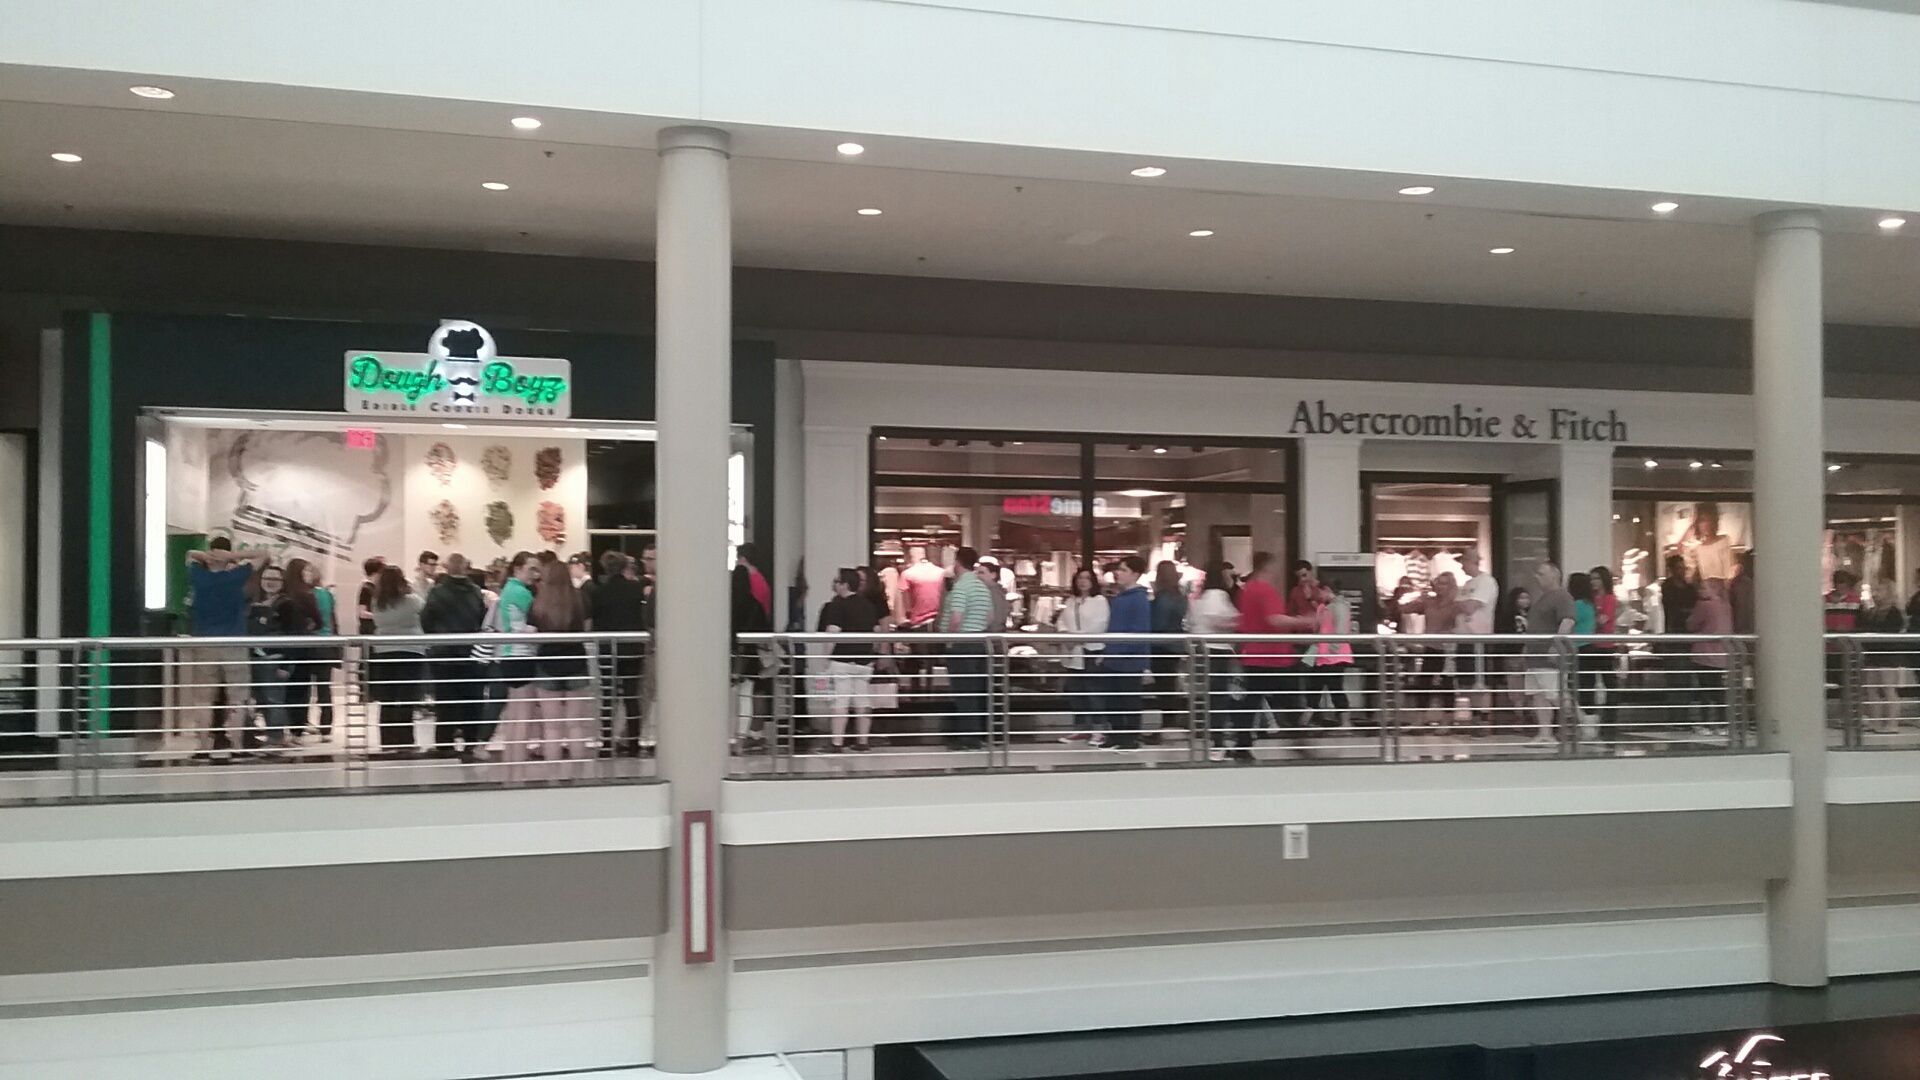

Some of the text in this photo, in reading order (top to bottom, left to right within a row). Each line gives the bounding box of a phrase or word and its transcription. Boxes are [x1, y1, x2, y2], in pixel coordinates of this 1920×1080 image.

[351, 356, 566, 404] Dough Boyz
[1289, 400, 1628, 442] Abercrombie & Fitch
